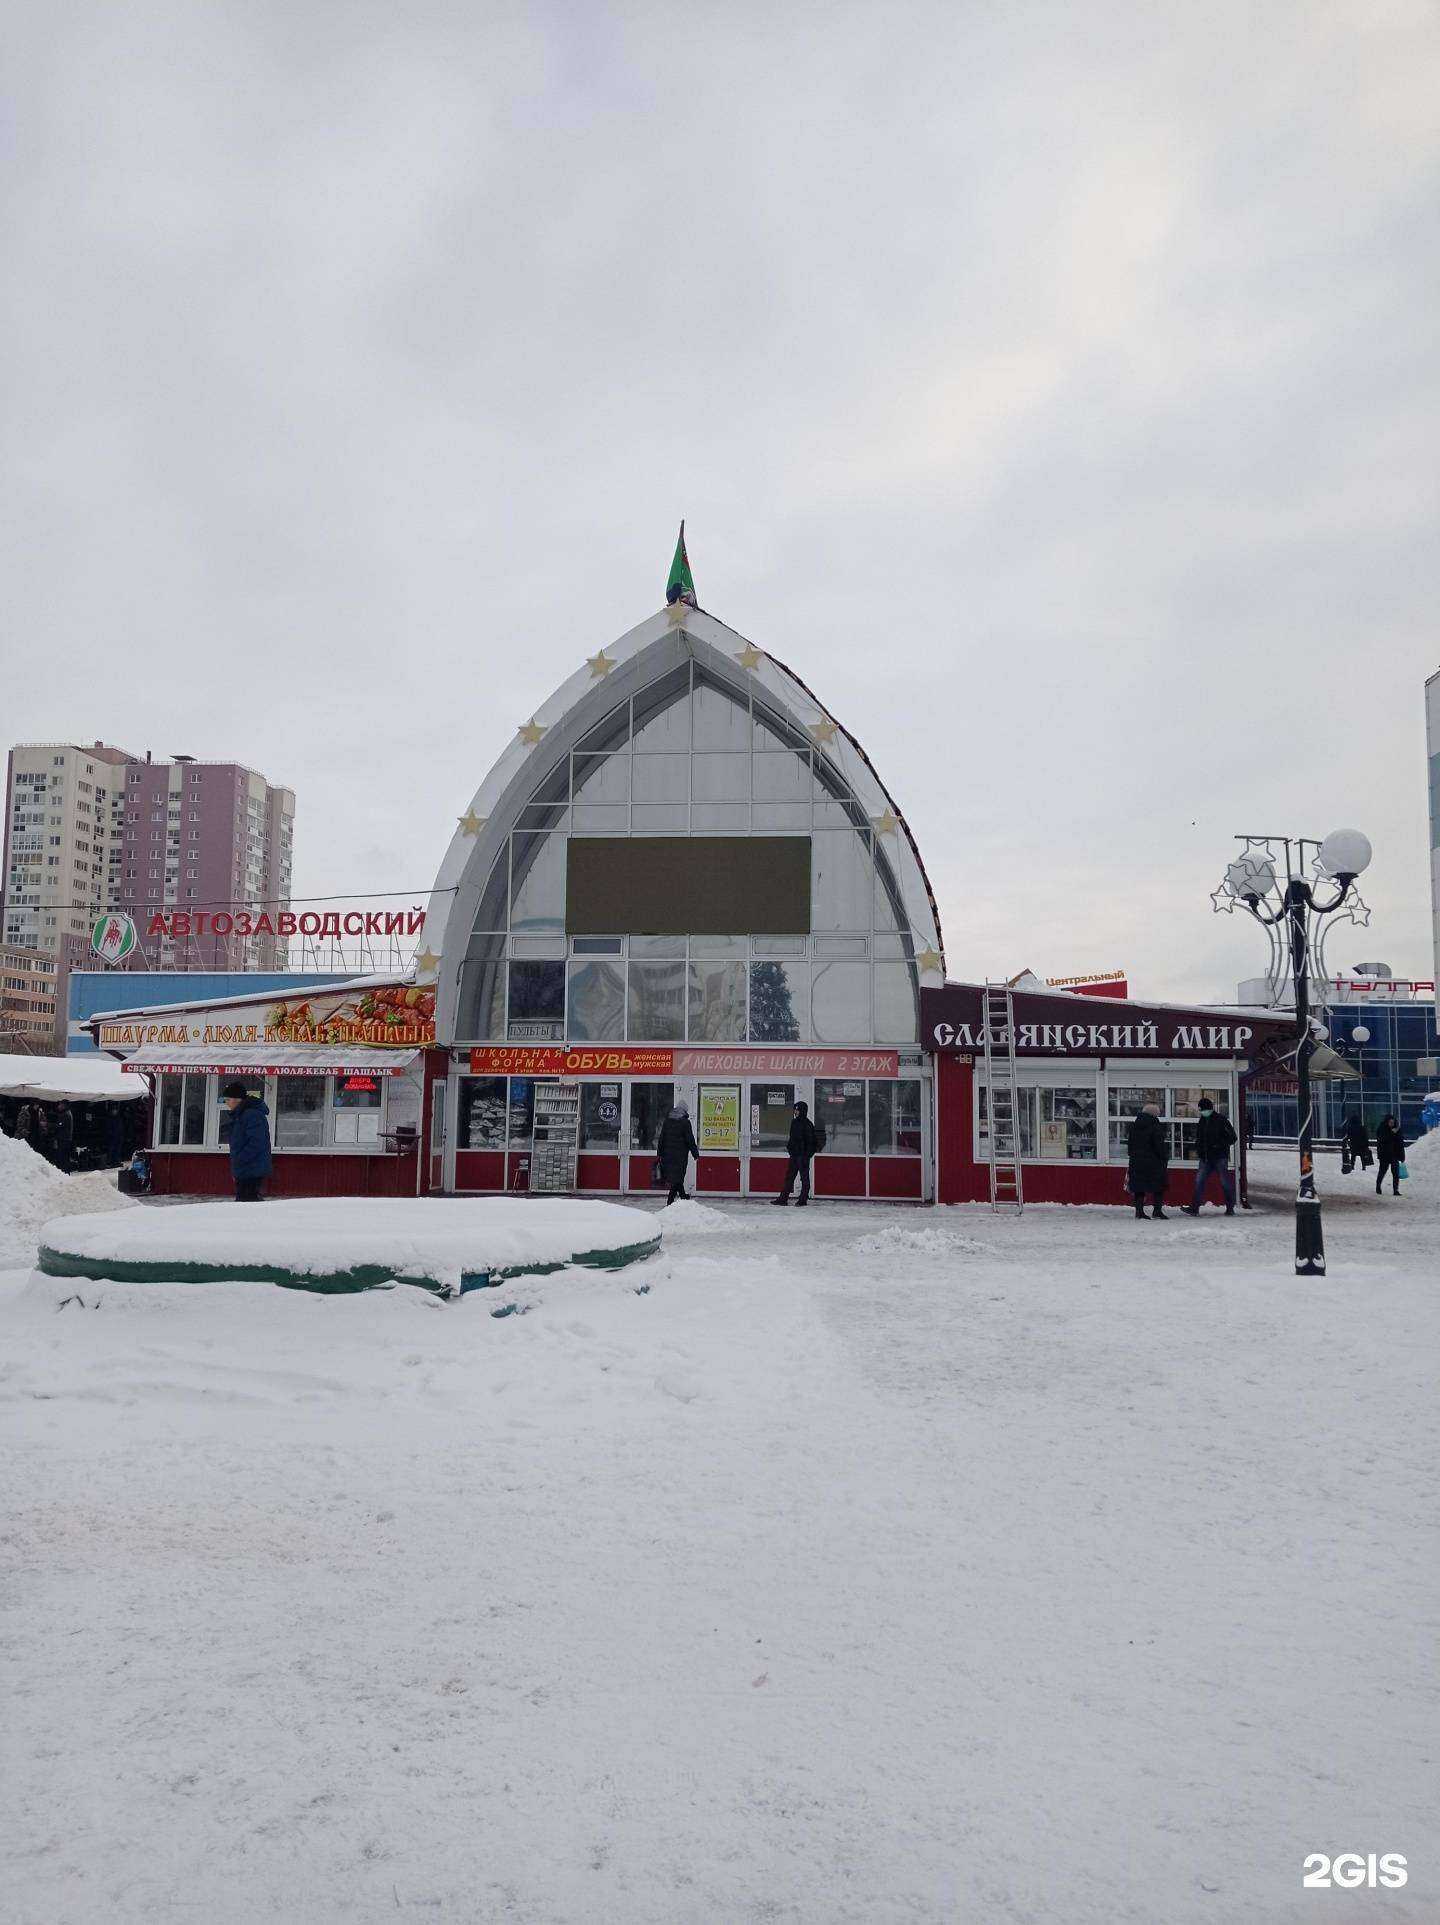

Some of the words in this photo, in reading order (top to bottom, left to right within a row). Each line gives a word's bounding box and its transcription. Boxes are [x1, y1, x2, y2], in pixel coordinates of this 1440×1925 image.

[147, 905, 427, 940] АВТОЗАВОДСКИЙ
[1046, 970, 1125, 986] Центральный
[101, 1025, 190, 1047] ШАУРМА
[933, 1018, 1159, 1050] СЛАВЯНСКИЙ
[1171, 1026, 1254, 1050] МИР
[475, 1049, 562, 1058] ШКОЛЬНАЯ
[566, 1053, 633, 1069] ОБУВЬ
[126, 1065, 169, 1073] СВЕЖАЯ
[171, 1065, 220, 1074] ВЫПЕЧКА
[224, 1065, 268, 1074] ШАУРМА
[273, 1067, 339, 1075] ЛЮЛЯ-КЕБАБ
[343, 1068, 393, 1076] ШАШЛЫК
[491, 1059, 546, 1068] ФОРМА
[693, 1055, 765, 1070] МЕХОВЫЕ
[768, 1056, 825, 1070] ШАПКИ
[837, 1057, 847, 1071] 2
[850, 1057, 893, 1072] ЭТАЖ
